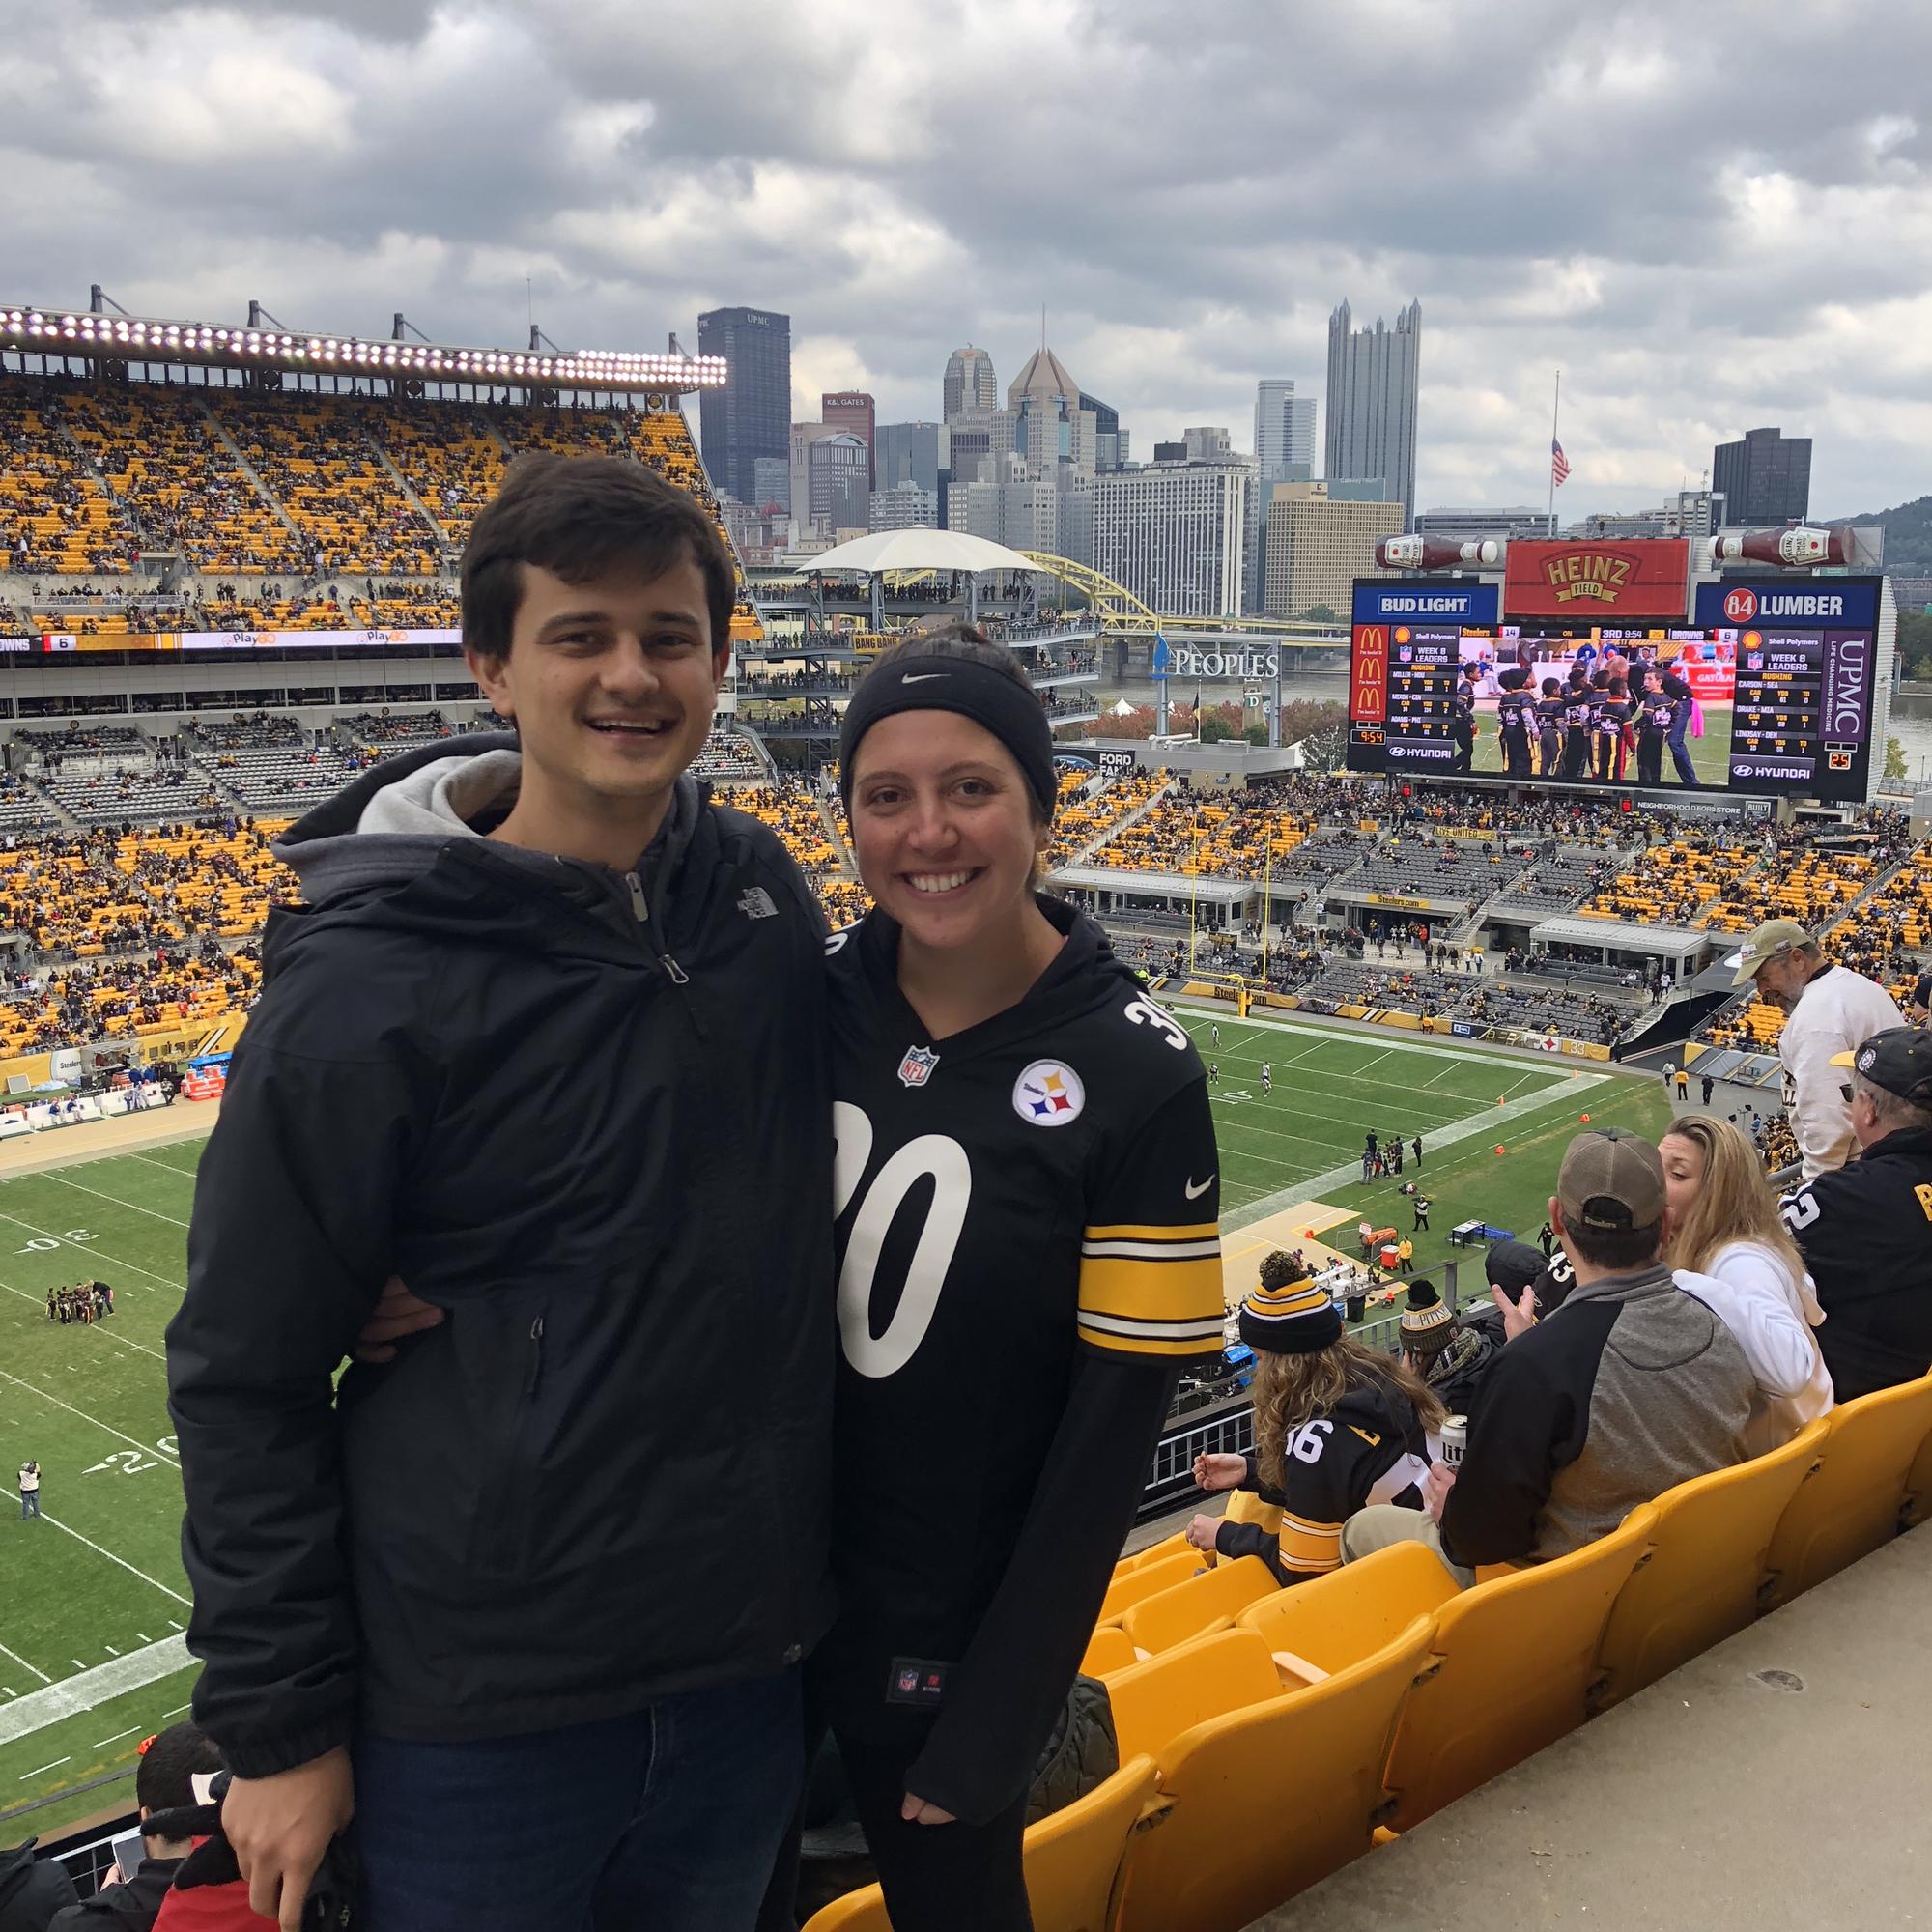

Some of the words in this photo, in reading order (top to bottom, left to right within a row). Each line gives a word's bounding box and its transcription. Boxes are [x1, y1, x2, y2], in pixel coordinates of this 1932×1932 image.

[747, 314, 771, 326] UPMC
[827, 398, 840, 407] K&L
[841, 398, 865, 407] GATES
[1547, 555, 1631, 587] HEINZ
[1574, 583, 1599, 595] FIELD
[1381, 597, 1416, 611] BUD
[1418, 597, 1467, 612] LIGHT
[1727, 595, 1753, 615] 84
[1760, 595, 1843, 616] LUMBER
[1602, 629, 1622, 638] 3RD
[1624, 629, 1642, 638] 9:54
[1672, 631, 1705, 639] BROWNS
[59, 638, 68, 649] 6
[855, 637, 876, 649] BANG
[877, 637, 897, 649] BANG
[1174, 649, 1279, 678] PEOPLES
[1771, 654, 1796, 662] WEEK
[1799, 654, 1806, 662] 8
[1768, 662, 1808, 671] LEADERS
[1827, 658, 1836, 696] CHANGING
[1835, 639, 1865, 734] UPMC
[1825, 698, 1834, 732] MEDICINE
[1361, 731, 1383, 743] 9:54
[1100, 753, 1132, 765] FORD
[1407, 748, 1451, 759] HYUNDAI
[1832, 754, 1849, 767] 25
[1756, 767, 1810, 779] HYUNDAI
[1747, 803, 1768, 813] BUILT
[1452, 829, 1478, 838] UNITED
[1378, 895, 1420, 907] Steelers.com
[1570, 1042, 1585, 1055] 33
[903, 1060, 924, 1080] NFL
[1023, 1082, 1046, 1097] Steelers
[1547, 1251, 1575, 1283] 43
